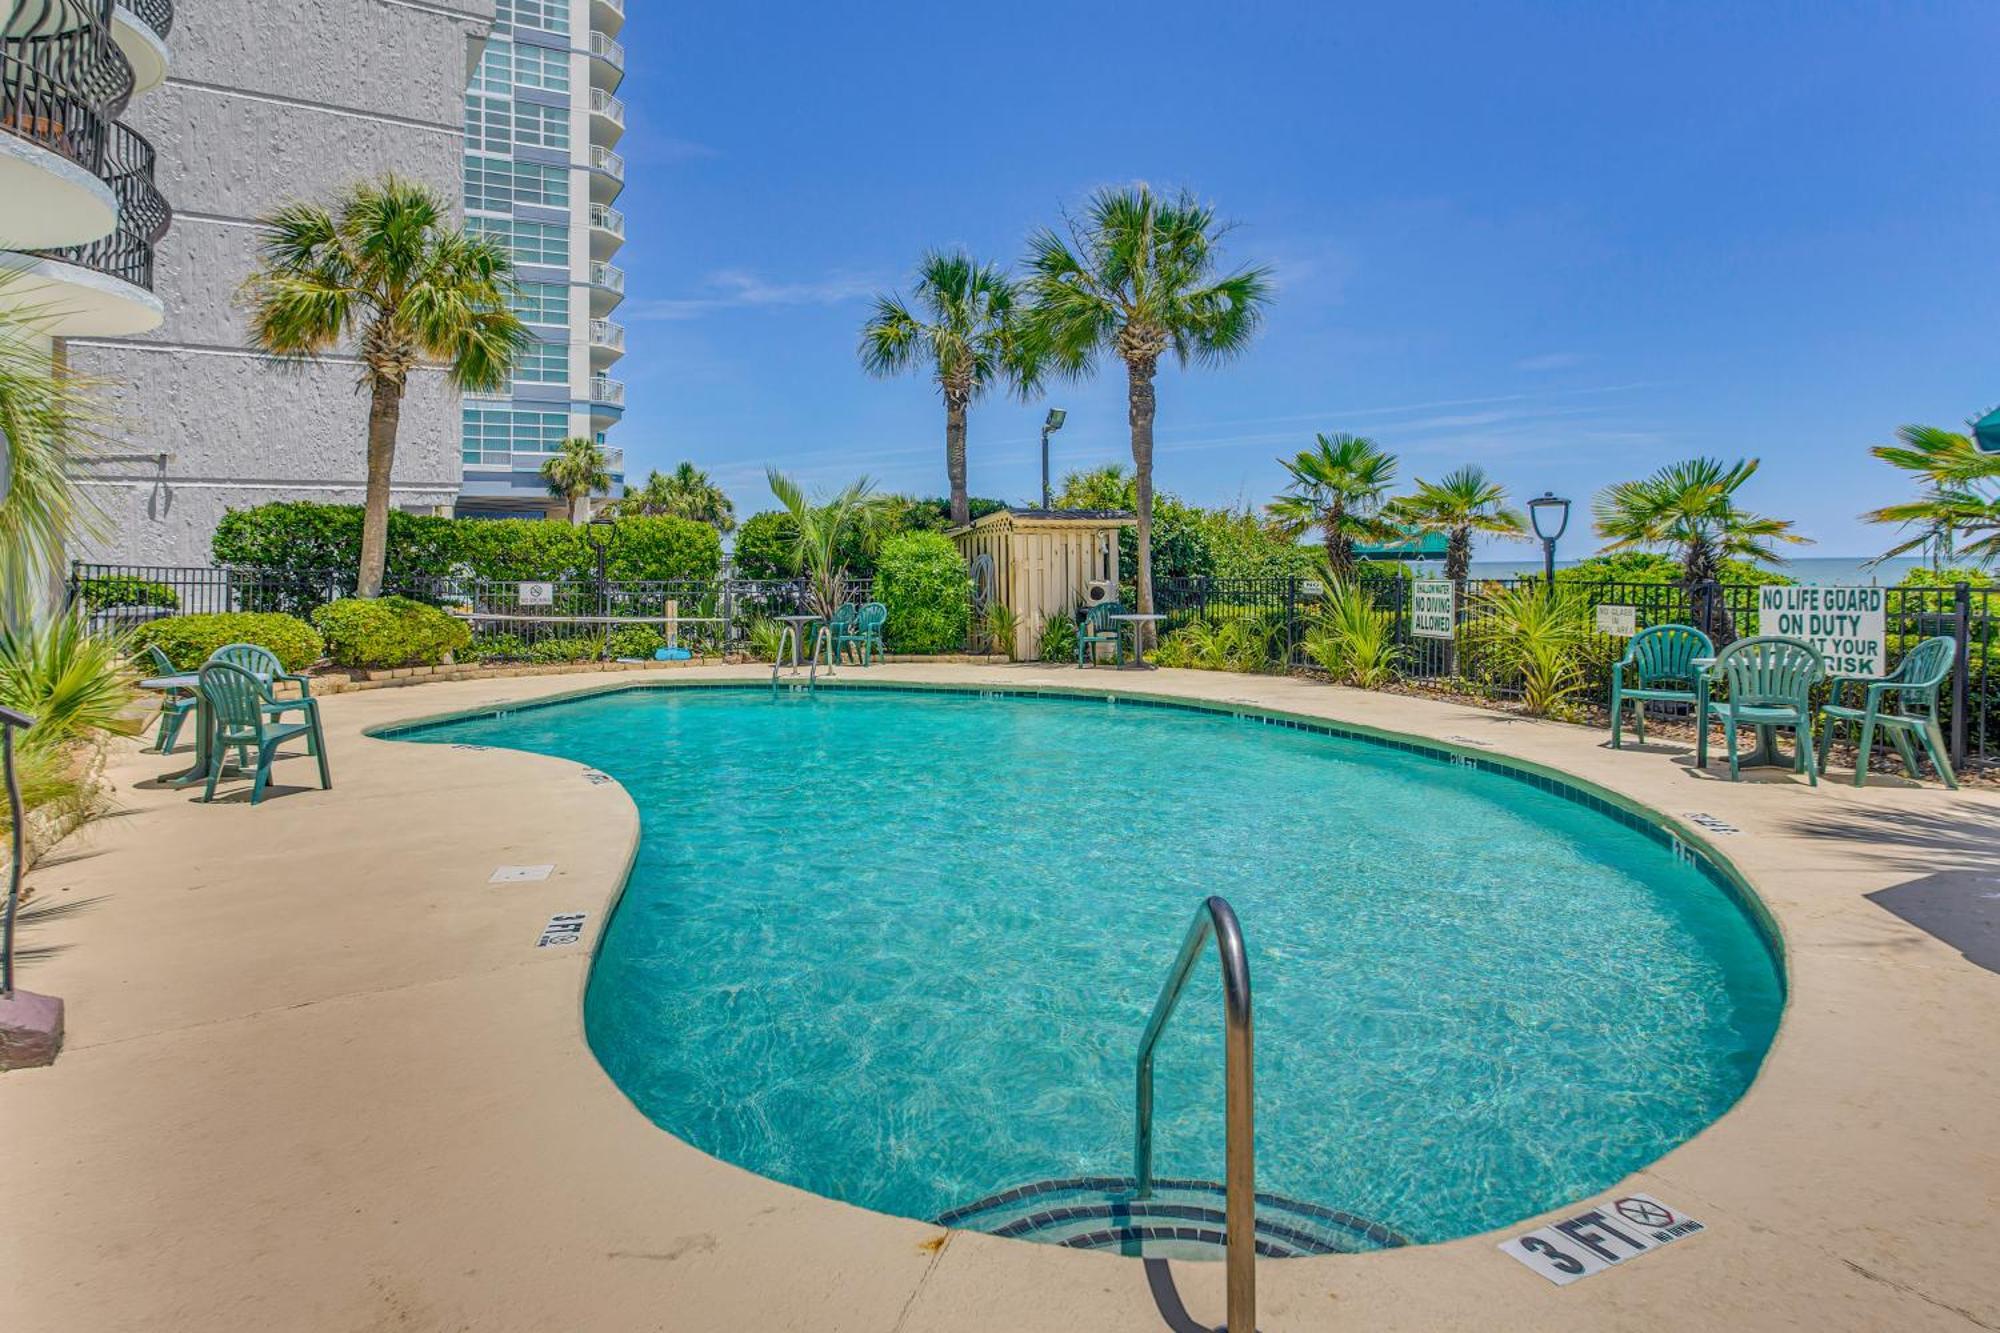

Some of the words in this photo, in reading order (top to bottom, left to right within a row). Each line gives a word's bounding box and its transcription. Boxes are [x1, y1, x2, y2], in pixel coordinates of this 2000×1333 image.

[1416, 597, 1424, 612] NO
[1427, 597, 1450, 613] DIVING
[1763, 589, 1782, 609] NO
[1788, 589, 1819, 610] LIFE
[1824, 590, 1880, 612] GUARD
[1416, 615, 1449, 631] ALLOWED
[1779, 614, 1803, 635] ON
[1810, 614, 1861, 637] DUTY
[1832, 639, 1878, 656] YOUR
[1519, 1236, 1585, 1274] 3
[1554, 1211, 1647, 1261] FT
